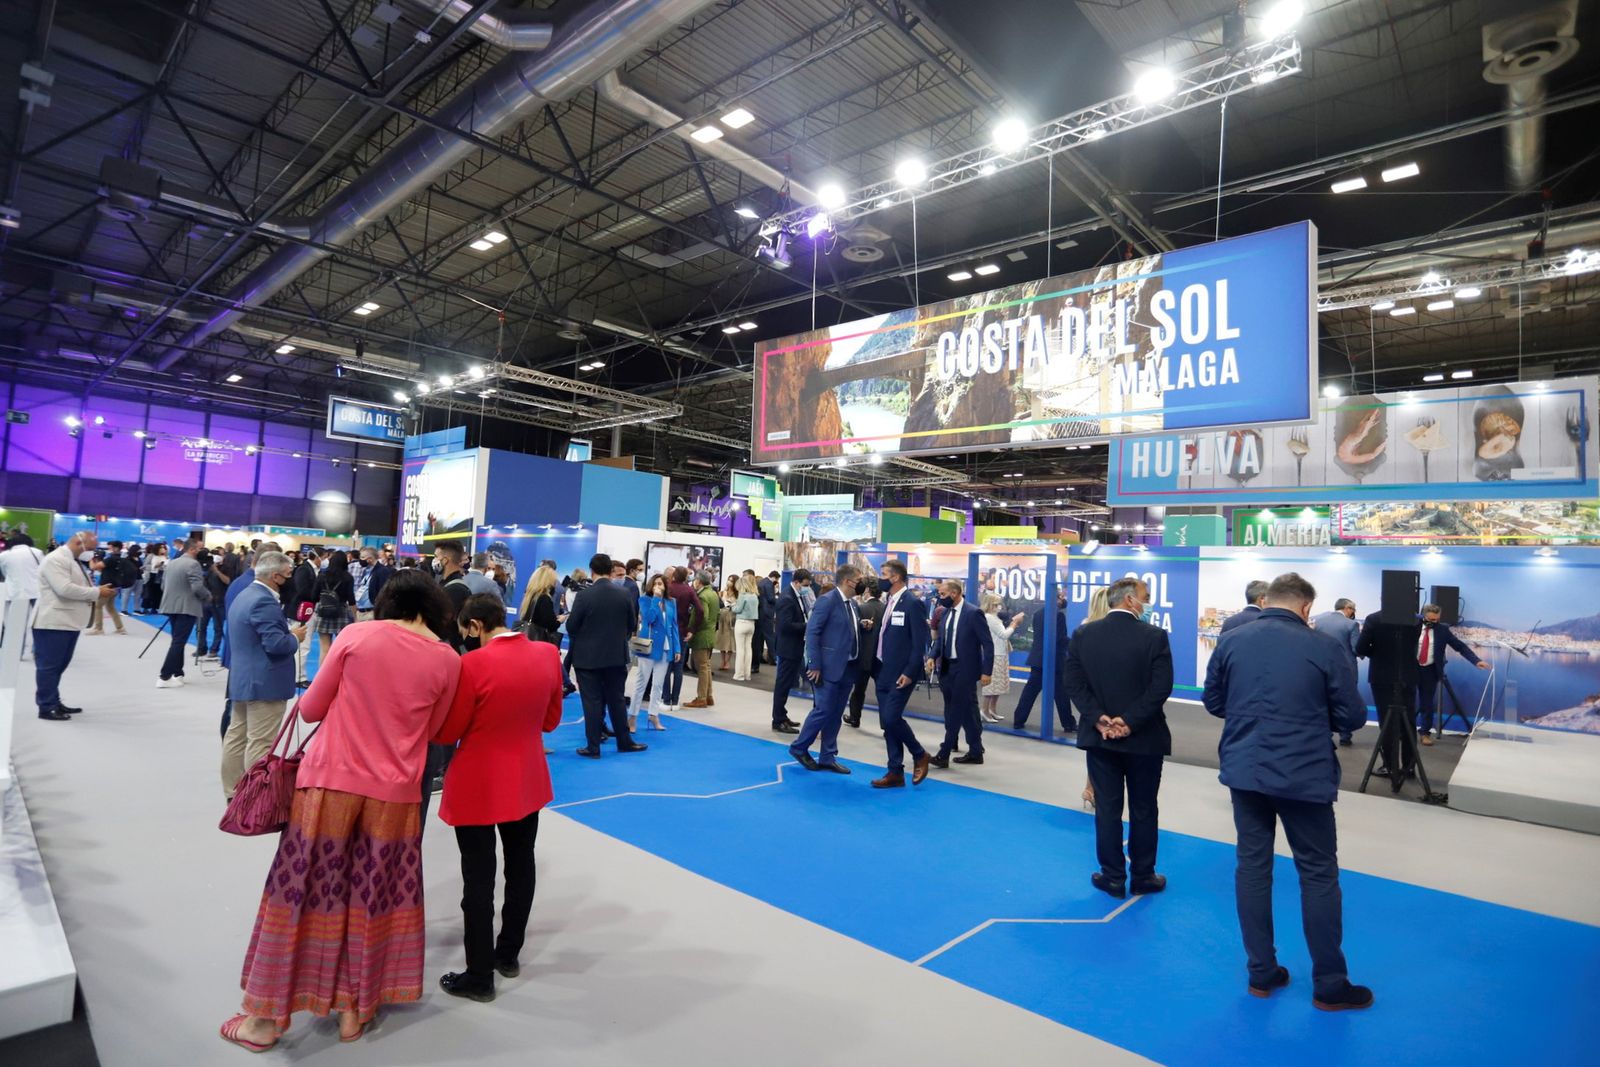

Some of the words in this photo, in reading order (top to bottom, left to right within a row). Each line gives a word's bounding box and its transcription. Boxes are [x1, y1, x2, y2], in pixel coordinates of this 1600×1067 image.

[936, 314, 1049, 379] COSTA
[1061, 298, 1137, 359] DEL
[1149, 279, 1240, 350] SOL
[341, 407, 373, 425] COSTA
[375, 413, 394, 428] DEL
[1132, 434, 1261, 478] HUELVA
[403, 498, 417, 521] DEL
[401, 522, 415, 545] SOL
